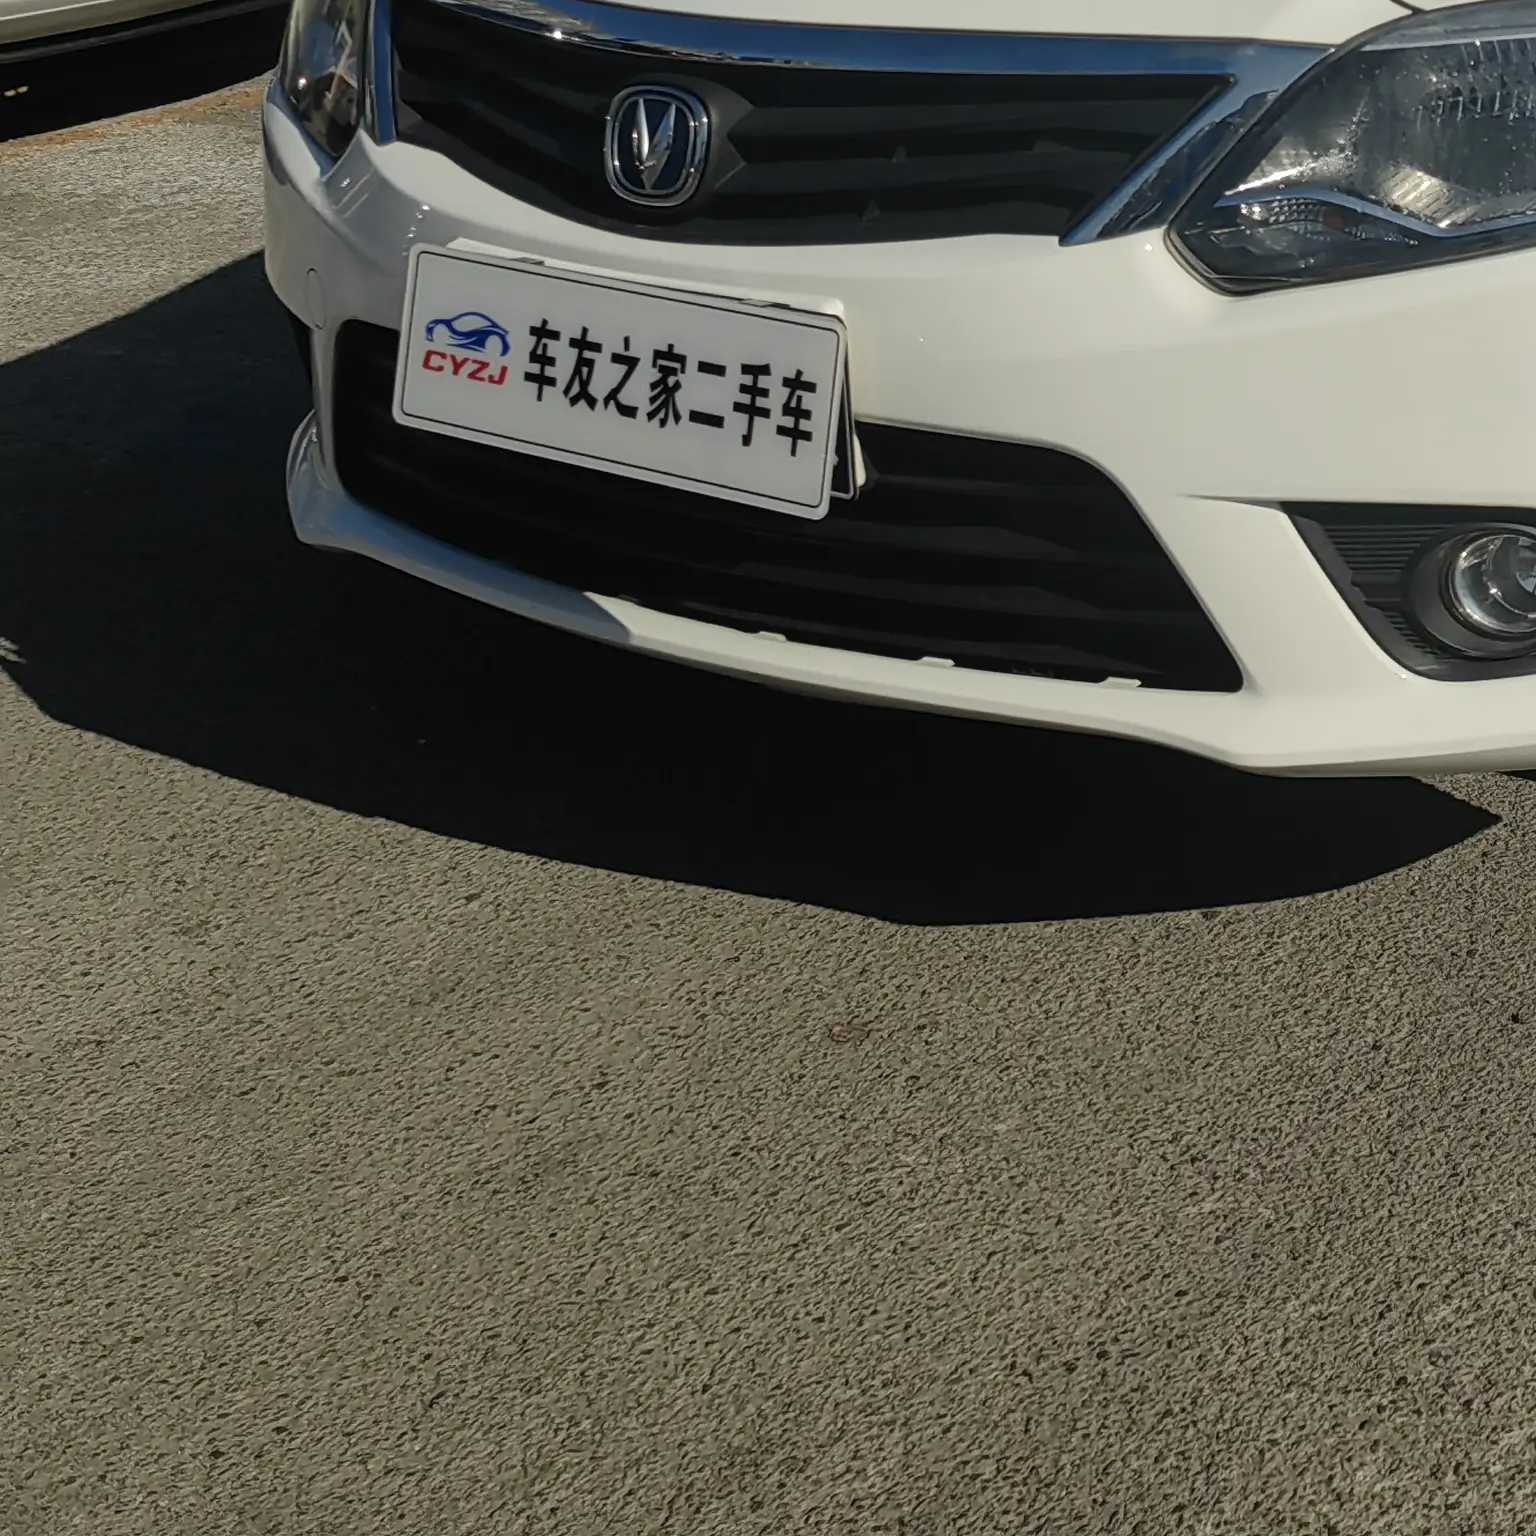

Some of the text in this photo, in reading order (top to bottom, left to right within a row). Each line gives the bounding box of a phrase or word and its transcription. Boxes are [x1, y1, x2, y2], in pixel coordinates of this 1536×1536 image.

[421, 348, 509, 387] CYZJ
[521, 317, 819, 459] 车友之家二手车
